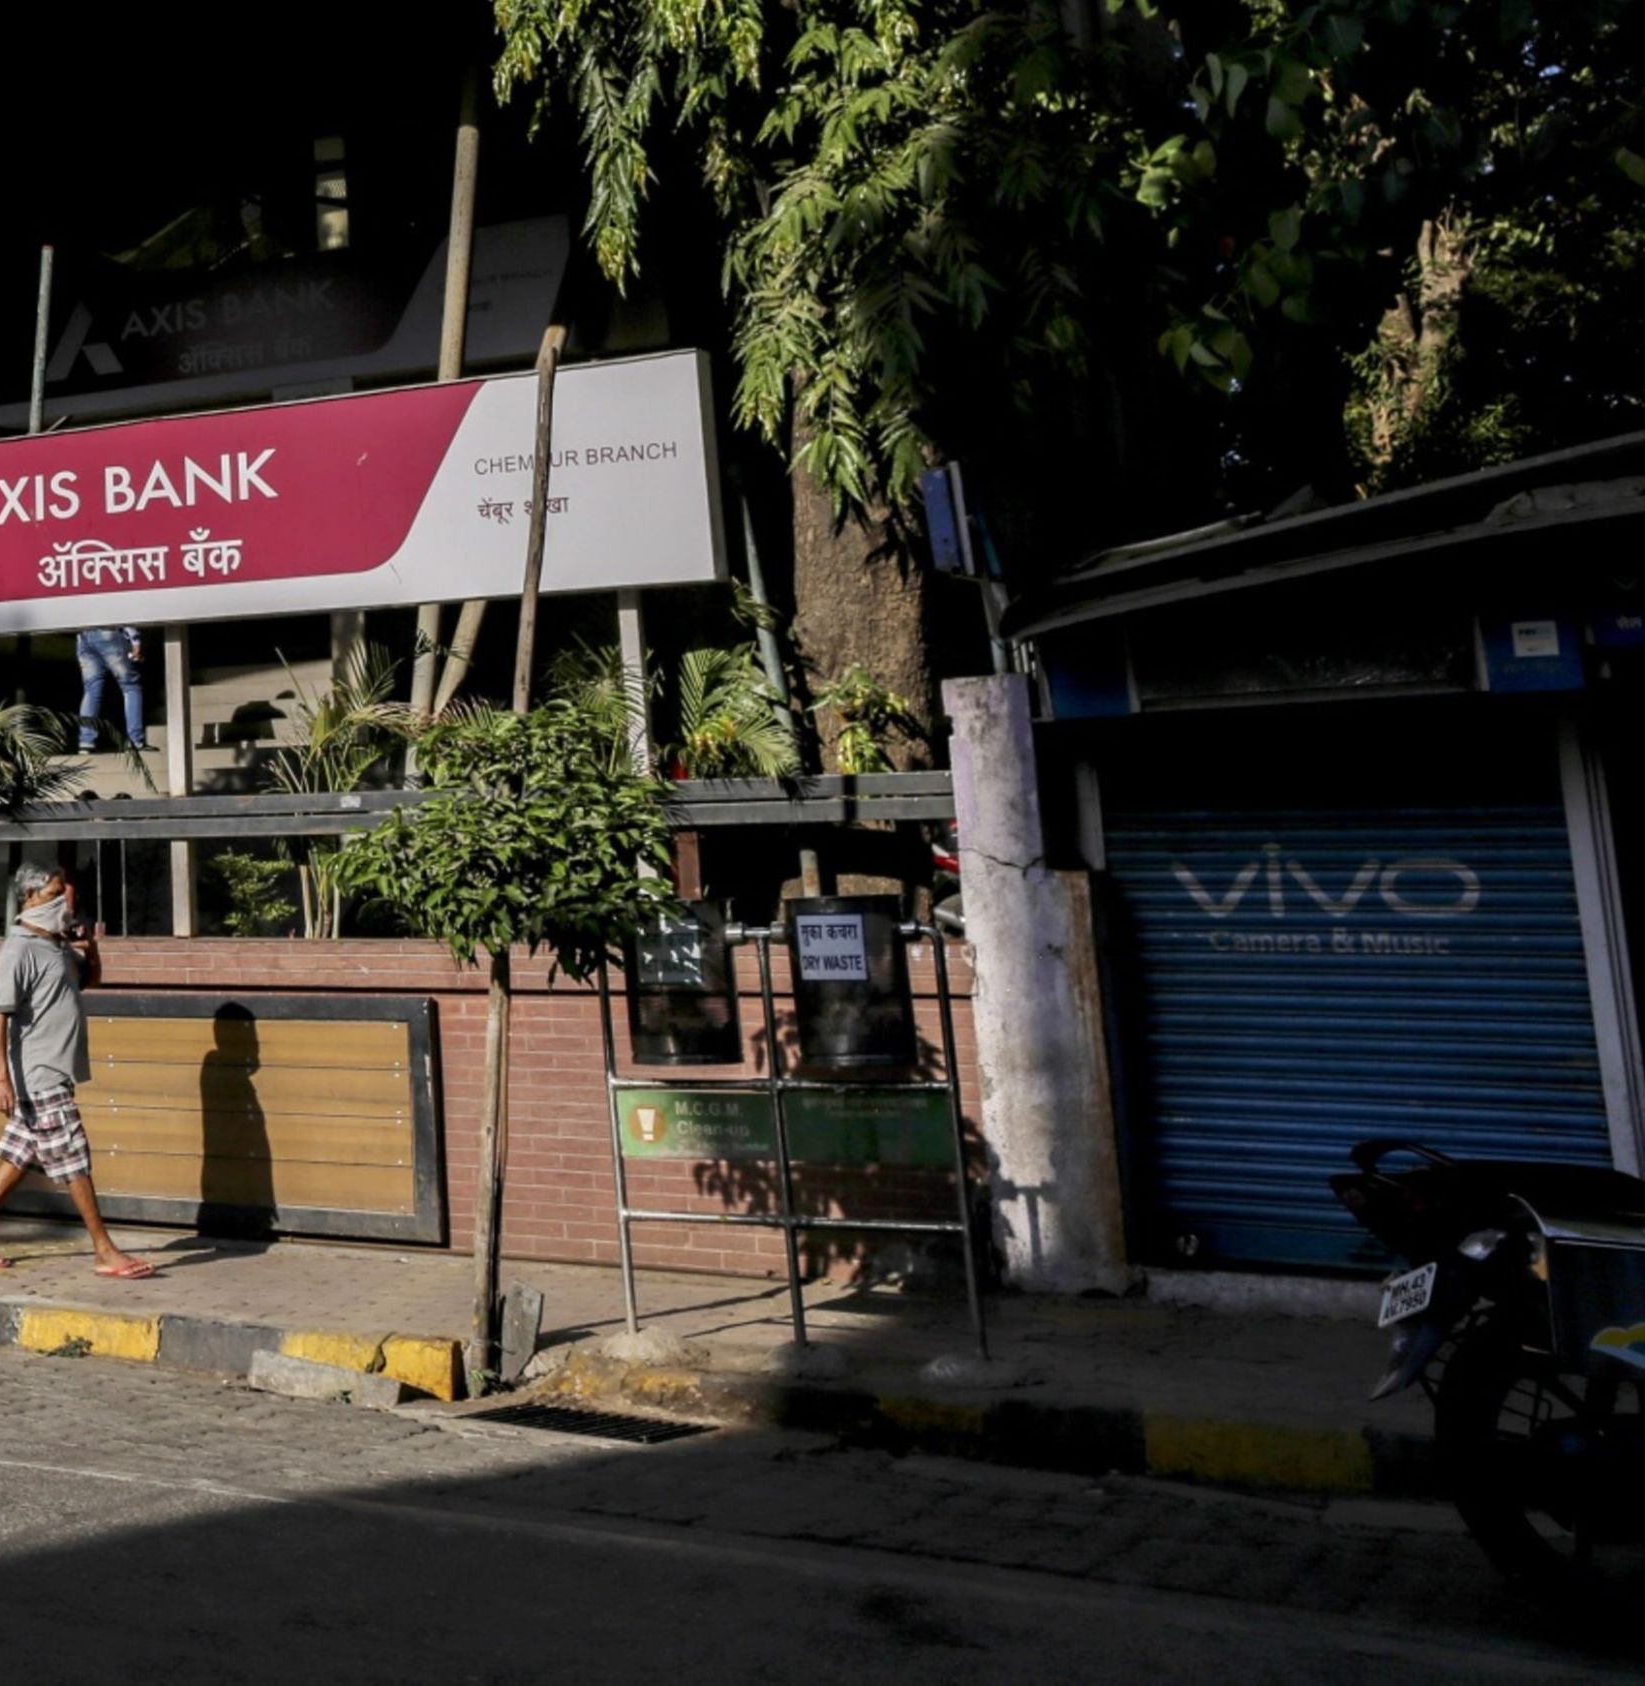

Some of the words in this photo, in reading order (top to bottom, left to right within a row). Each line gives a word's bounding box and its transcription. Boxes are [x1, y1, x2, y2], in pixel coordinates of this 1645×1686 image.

[120, 298, 206, 342] AXIS
[221, 277, 336, 324] BANK
[474, 449, 580, 476] CHEMUR
[585, 441, 678, 466] BRANCH
[103, 448, 279, 515] BANK
[523, 496, 569, 517] शखा
[1171, 842, 1481, 918] vivo
[1209, 930, 1322, 953] Camera
[1331, 926, 1354, 953] &
[1361, 931, 1451, 955] Music
[823, 955, 862, 970] WASTE
